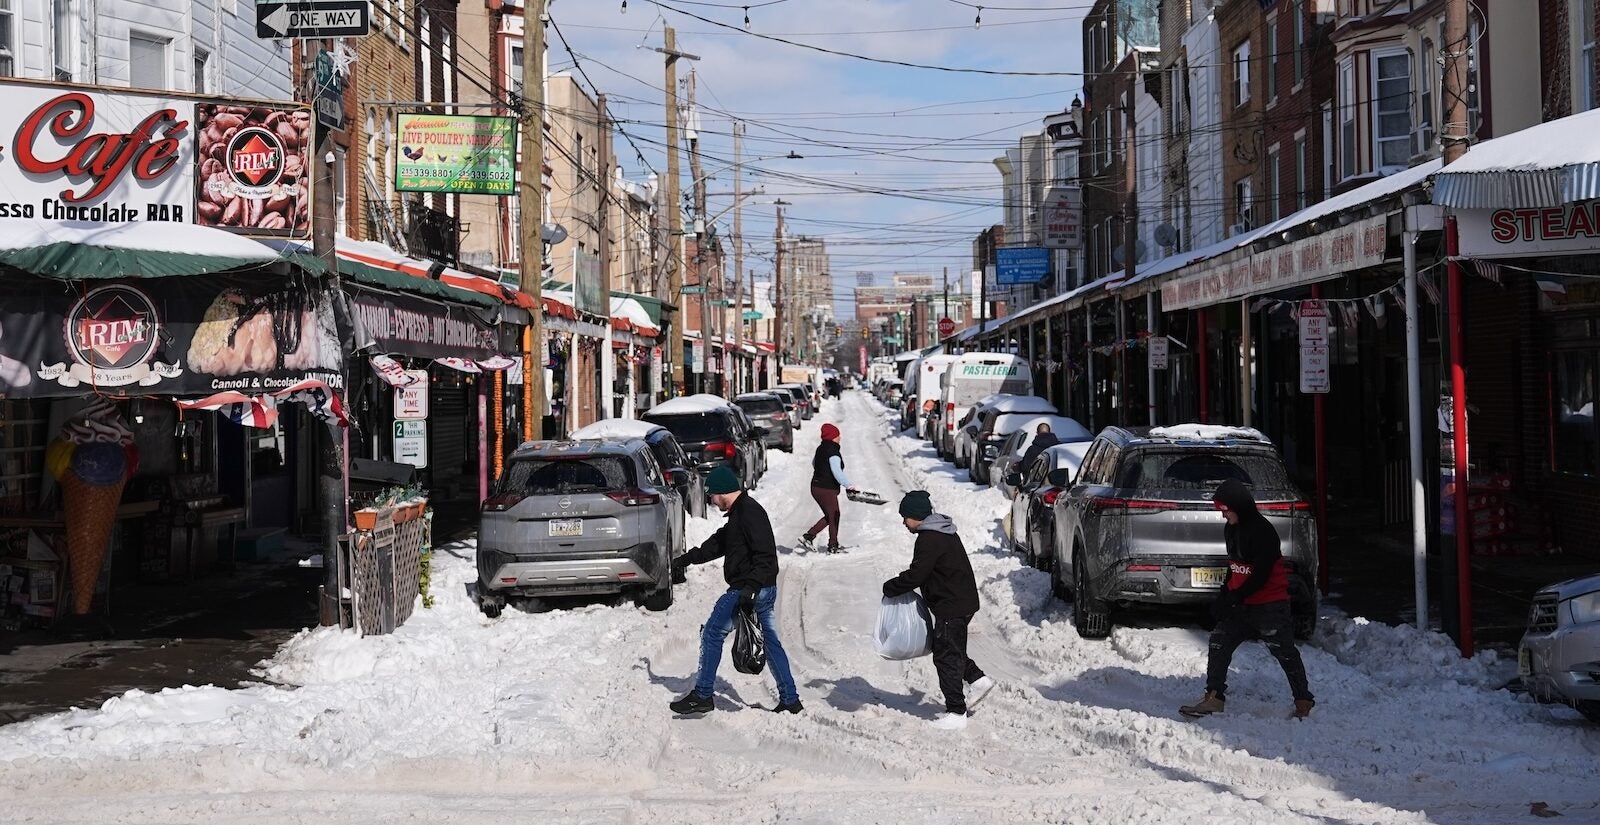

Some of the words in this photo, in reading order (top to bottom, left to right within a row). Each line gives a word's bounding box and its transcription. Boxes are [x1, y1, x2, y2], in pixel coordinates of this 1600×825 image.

[290, 12, 320, 26] ONE
[325, 11, 356, 26] WAY
[402, 132, 422, 144] LIVE
[424, 132, 464, 145] POULTRY
[14, 92, 188, 203] Café
[402, 167, 413, 175] 215
[414, 168, 453, 177] 339.8801
[471, 171, 510, 180] 339.5022
[450, 180, 477, 189] OPEN
[486, 182, 510, 190] DAYS
[42, 198, 139, 222] Chocolate
[147, 203, 184, 222] BAR
[1491, 202, 1600, 243] STEA
[394, 308, 429, 344] ESPRESSO
[939, 322, 954, 330] STOP
[211, 377, 249, 389] Cannoli
[251, 378, 260, 388] &
[396, 423, 403, 436] 2
